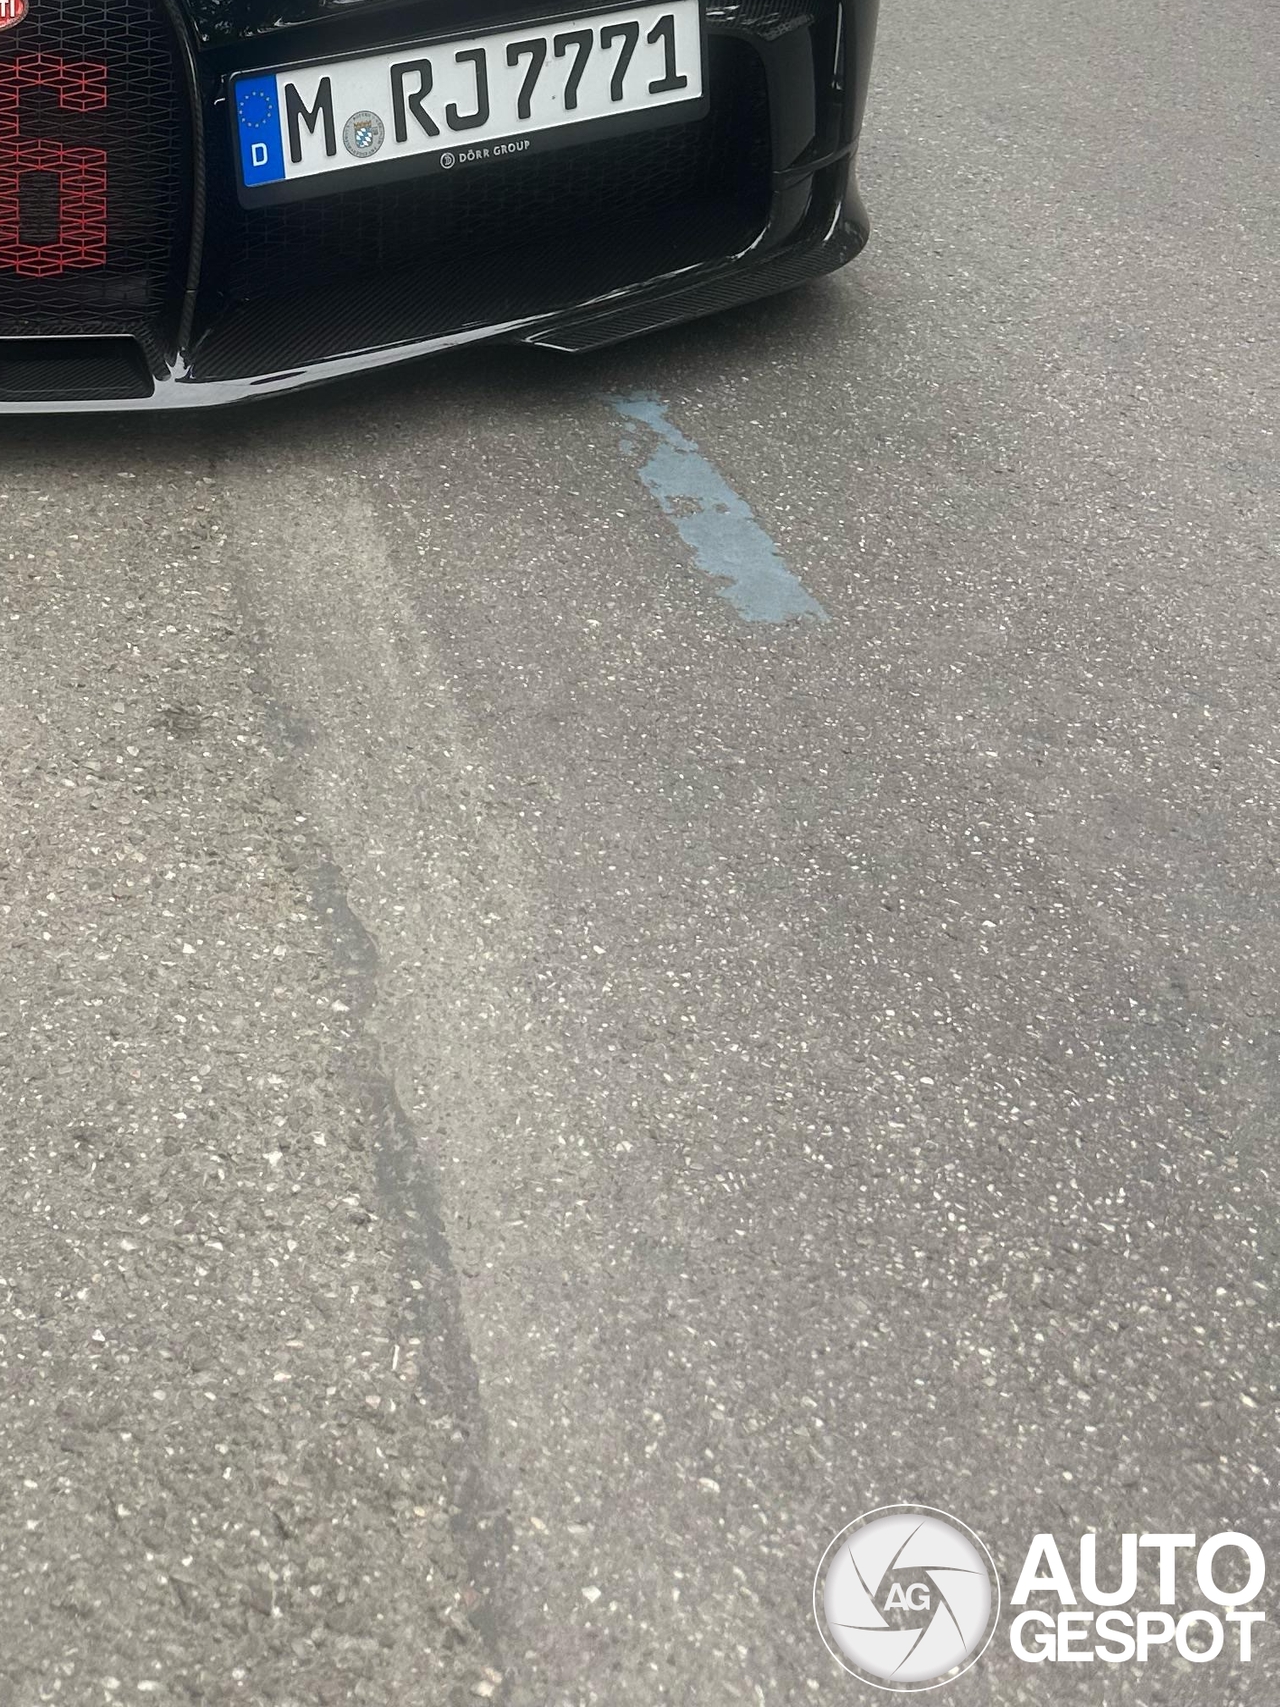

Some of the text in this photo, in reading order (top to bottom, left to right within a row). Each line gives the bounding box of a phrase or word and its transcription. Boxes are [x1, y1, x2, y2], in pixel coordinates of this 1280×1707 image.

[284, 76, 337, 164] M
[251, 143, 268, 167] D
[459, 149, 490, 163] DÖRR
[493, 140, 530, 156] GROUP
